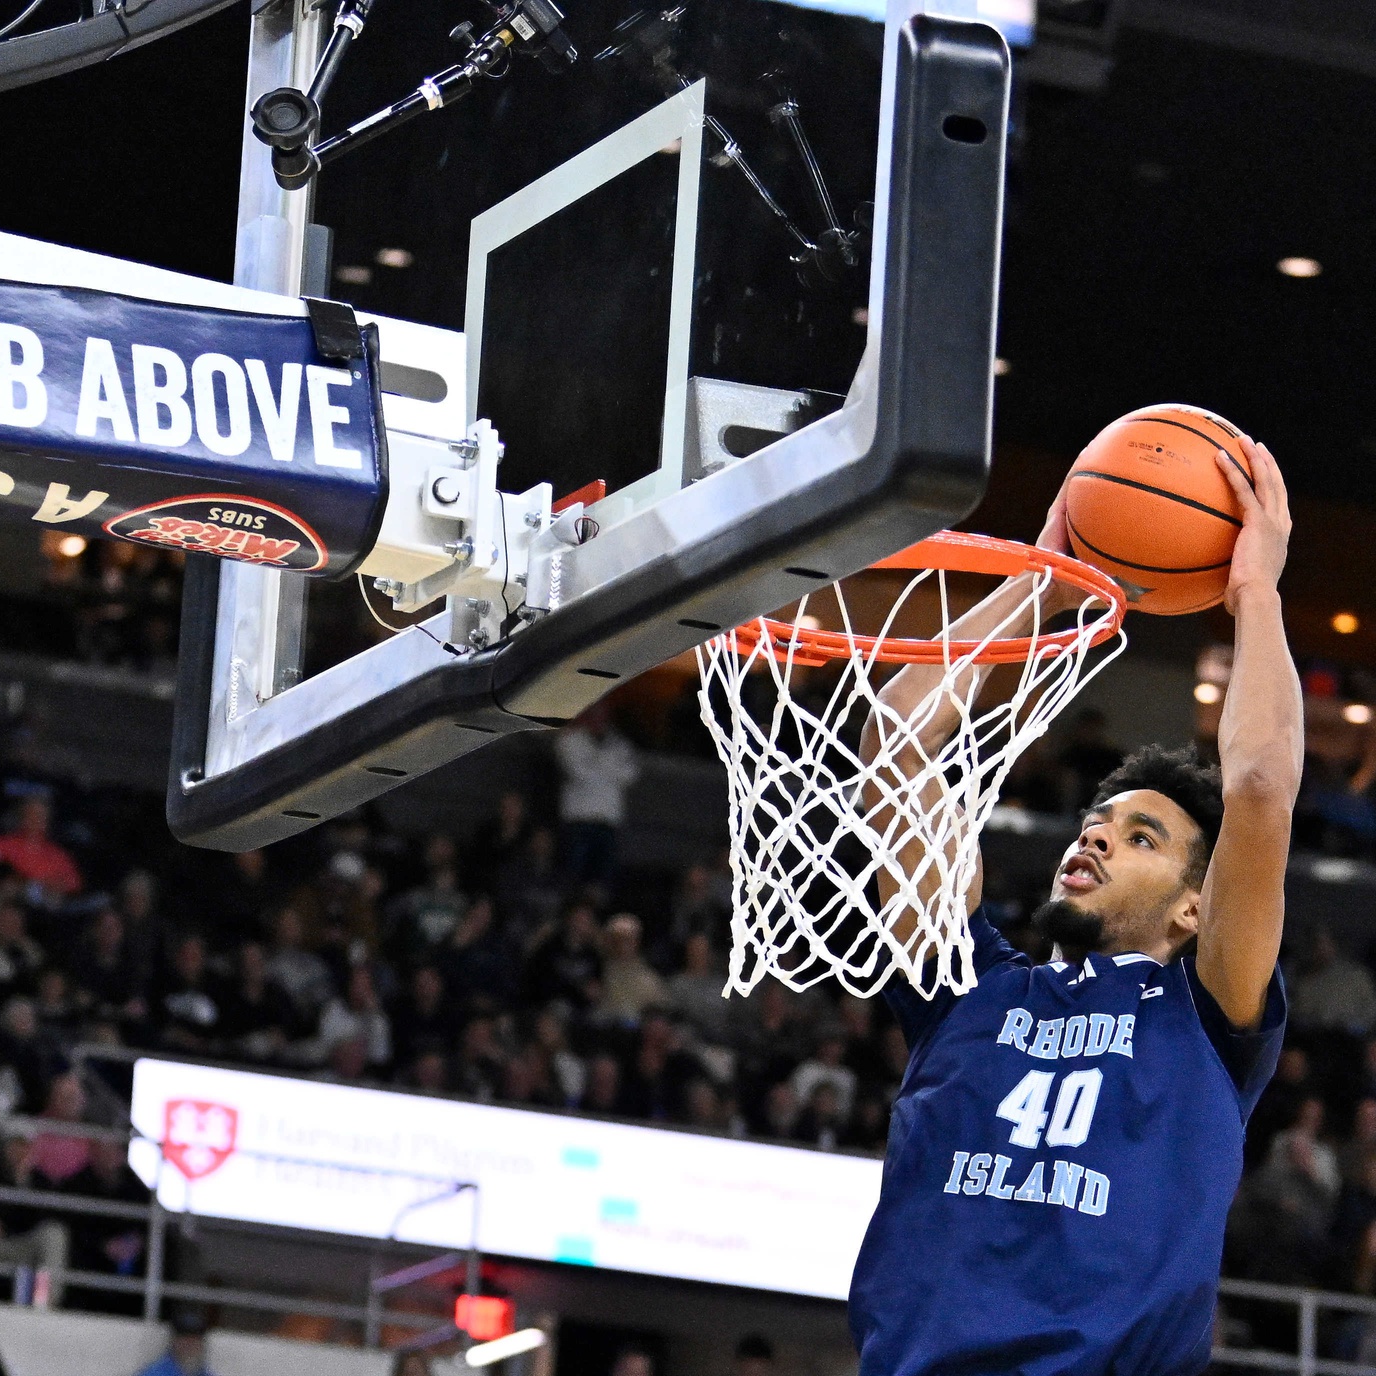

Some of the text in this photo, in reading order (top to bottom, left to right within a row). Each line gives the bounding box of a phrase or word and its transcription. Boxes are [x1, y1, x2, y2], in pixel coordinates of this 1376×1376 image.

[74, 336, 364, 471] ABOVE
[30, 481, 111, 525] A
[207, 506, 267, 530] SUBS
[996, 1007, 1136, 1060] RHODE
[995, 1066, 1105, 1150] 40
[942, 1150, 1111, 1217] ISLAND
